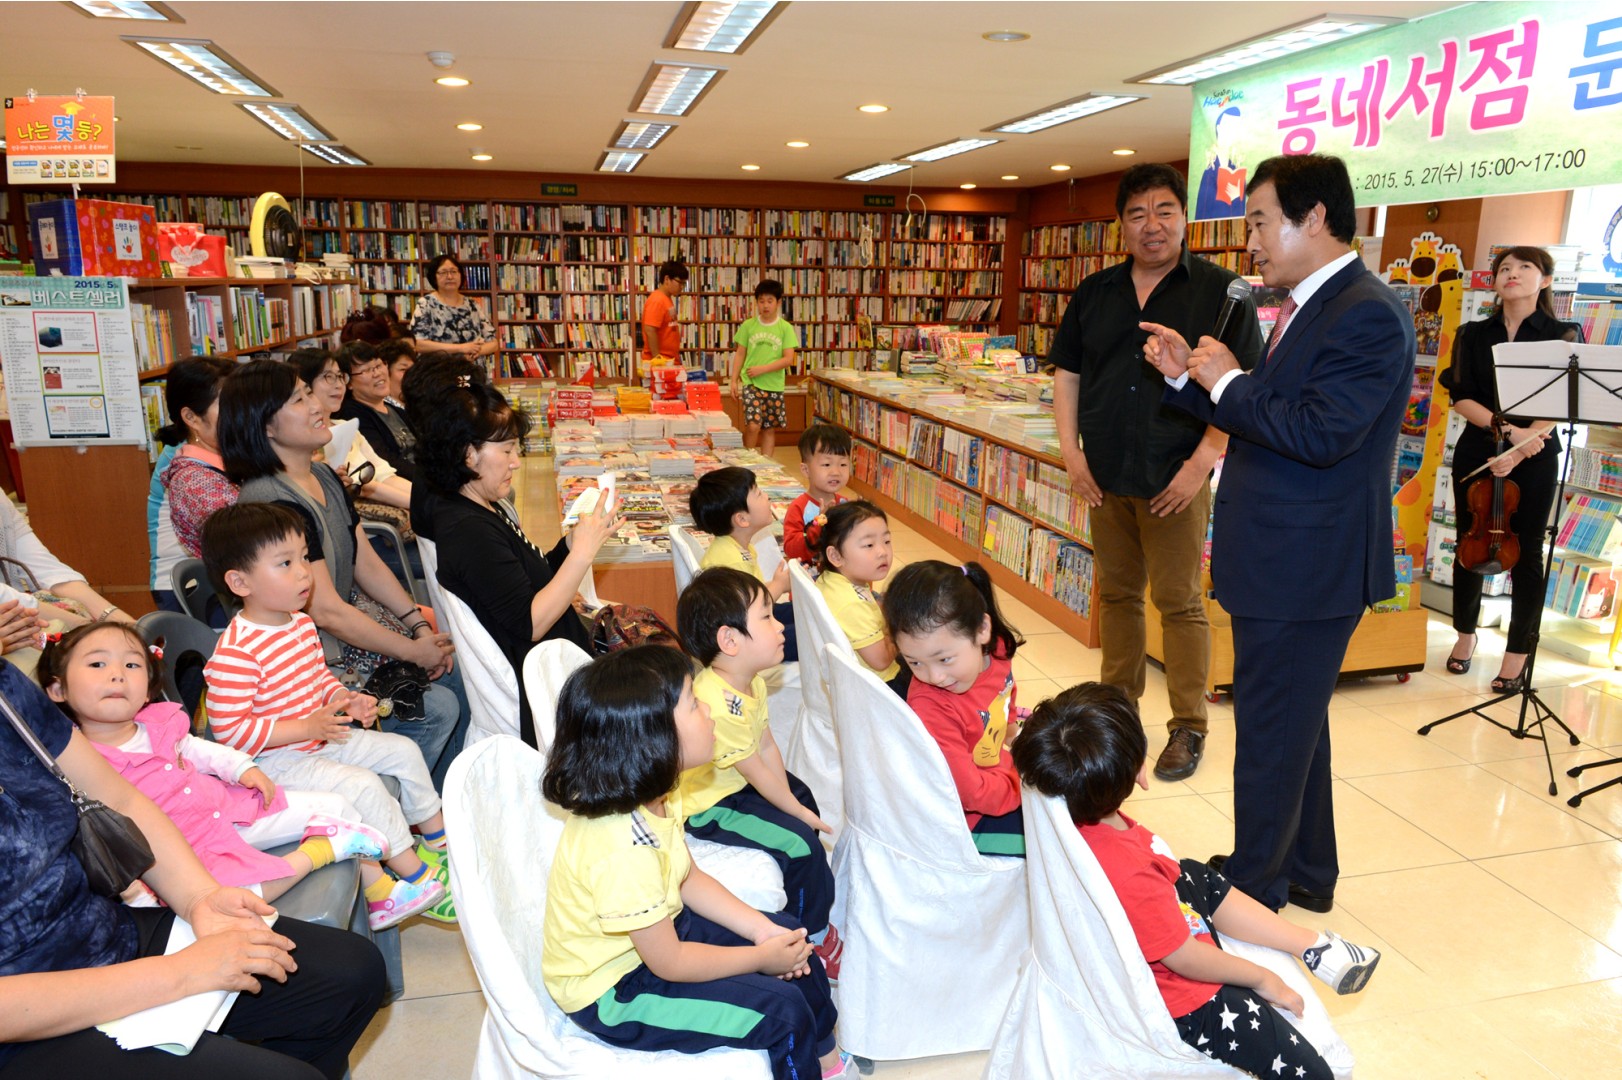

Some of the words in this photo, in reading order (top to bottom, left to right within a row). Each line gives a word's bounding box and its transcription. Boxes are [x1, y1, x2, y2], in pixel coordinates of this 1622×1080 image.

[1278, 19, 1540, 155] 동네서점
[17, 120, 51, 141] 나는
[53, 114, 75, 142] 몇
[75, 120, 103, 141] 등?
[1364, 172, 1398, 190] 2015.
[1404, 170, 1416, 188] 5.
[1421, 160, 1464, 184] 27(수)
[1470, 147, 1587, 180] 15:00~17:00
[31, 289, 122, 307] 베스트셀러
